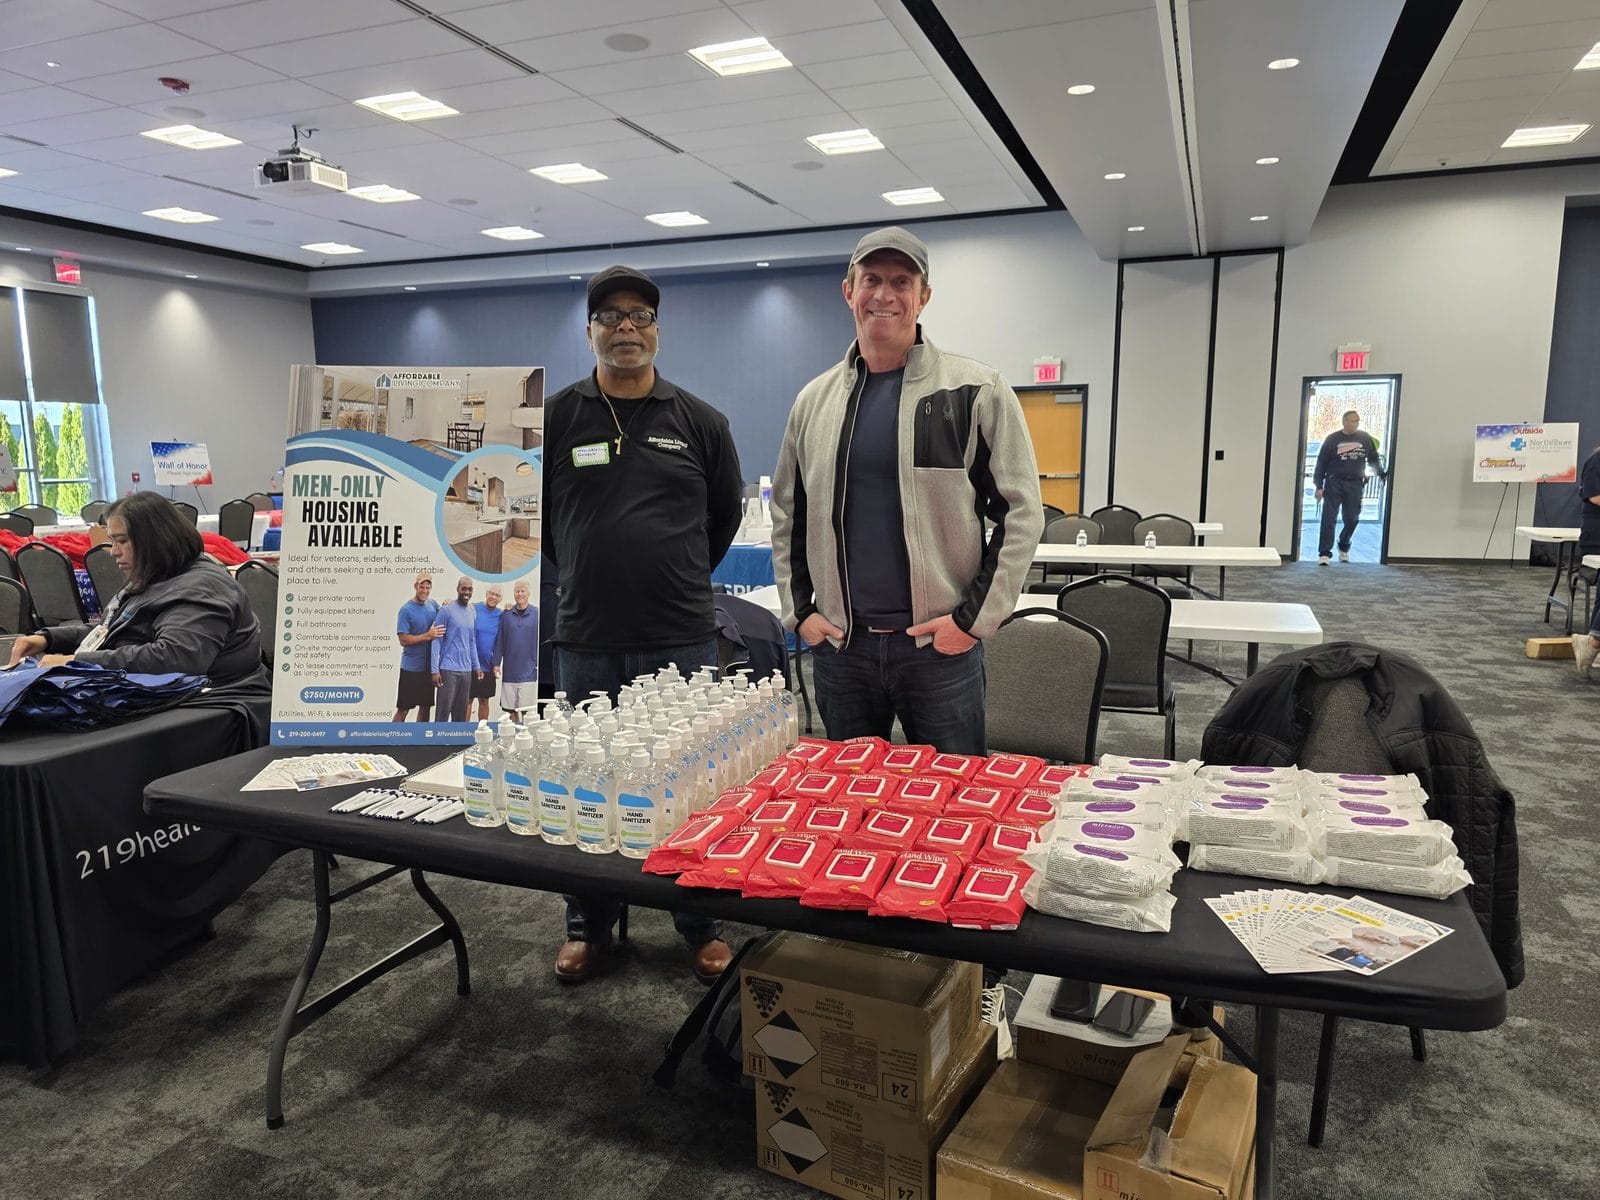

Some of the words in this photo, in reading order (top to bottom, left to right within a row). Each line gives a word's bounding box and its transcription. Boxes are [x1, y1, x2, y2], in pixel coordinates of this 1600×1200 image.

[1343, 355, 1364, 370] EXIT
[393, 373, 442, 381] AFFORDABLE
[1038, 367, 1057, 381] EXIT
[393, 380, 420, 388] LIVING
[421, 380, 461, 388] COMPANY
[1512, 427, 1544, 435] Outside
[157, 461, 175, 470] Wall
[176, 462, 184, 470] of
[186, 462, 208, 470] Honor
[292, 474, 386, 498] MEN-ONLY
[302, 500, 379, 524] HOUSING
[307, 524, 403, 548] AVAILABLE
[288, 554, 309, 562] Ideal
[311, 554, 323, 562] for
[324, 555, 361, 564] veterans,
[364, 554, 393, 565] elderly,
[394, 554, 431, 564] disabled,
[287, 565, 304, 573] and
[306, 566, 332, 574] others
[333, 566, 364, 576] seeking
[374, 566, 393, 576] safe,
[395, 566, 445, 575] comfortable
[286, 576, 310, 586] place
[312, 576, 321, 584] to
[322, 576, 339, 585] live.
[298, 595, 317, 603] Large
[319, 595, 343, 603] private
[297, 607, 313, 615] Fully
[314, 607, 347, 617] equipped
[310, 620, 348, 629] bathrooms
[296, 633, 340, 641] Comfortable
[294, 644, 321, 652] On-site
[322, 645, 353, 654] manager
[365, 645, 391, 654] support
[294, 651, 309, 659] and
[310, 651, 332, 661] safety
[293, 662, 305, 670] No
[307, 662, 325, 670] lease
[326, 662, 369, 670] commitment
[379, 662, 394, 672] stay
[304, 669, 319, 678] long
[331, 671, 343, 679] you
[304, 690, 361, 700] $750/MONTH
[278, 709, 307, 719] (Utilities,
[308, 709, 325, 719] Wi-Fi,
[327, 710, 335, 718] &
[336, 709, 365, 718] essentials
[366, 710, 394, 719] covered)
[350, 729, 414, 739] affordableliving7715.com
[465, 785, 490, 795] SANITIZER
[469, 781, 483, 789] HAND
[506, 792, 530, 802] SANITIZER
[509, 788, 524, 796] HAND
[544, 797, 560, 805] HAND
[540, 801, 567, 812] SANITIZER
[581, 805, 597, 813] HAND
[577, 811, 605, 820] SANITIZER
[621, 816, 651, 824] SANITIZER
[900, 852, 923, 861] Hand
[924, 854, 949, 864] Wipes
[891, 1082, 909, 1099] 24
[844, 1177, 874, 1193] HA-500
[897, 1186, 914, 1200] 24
